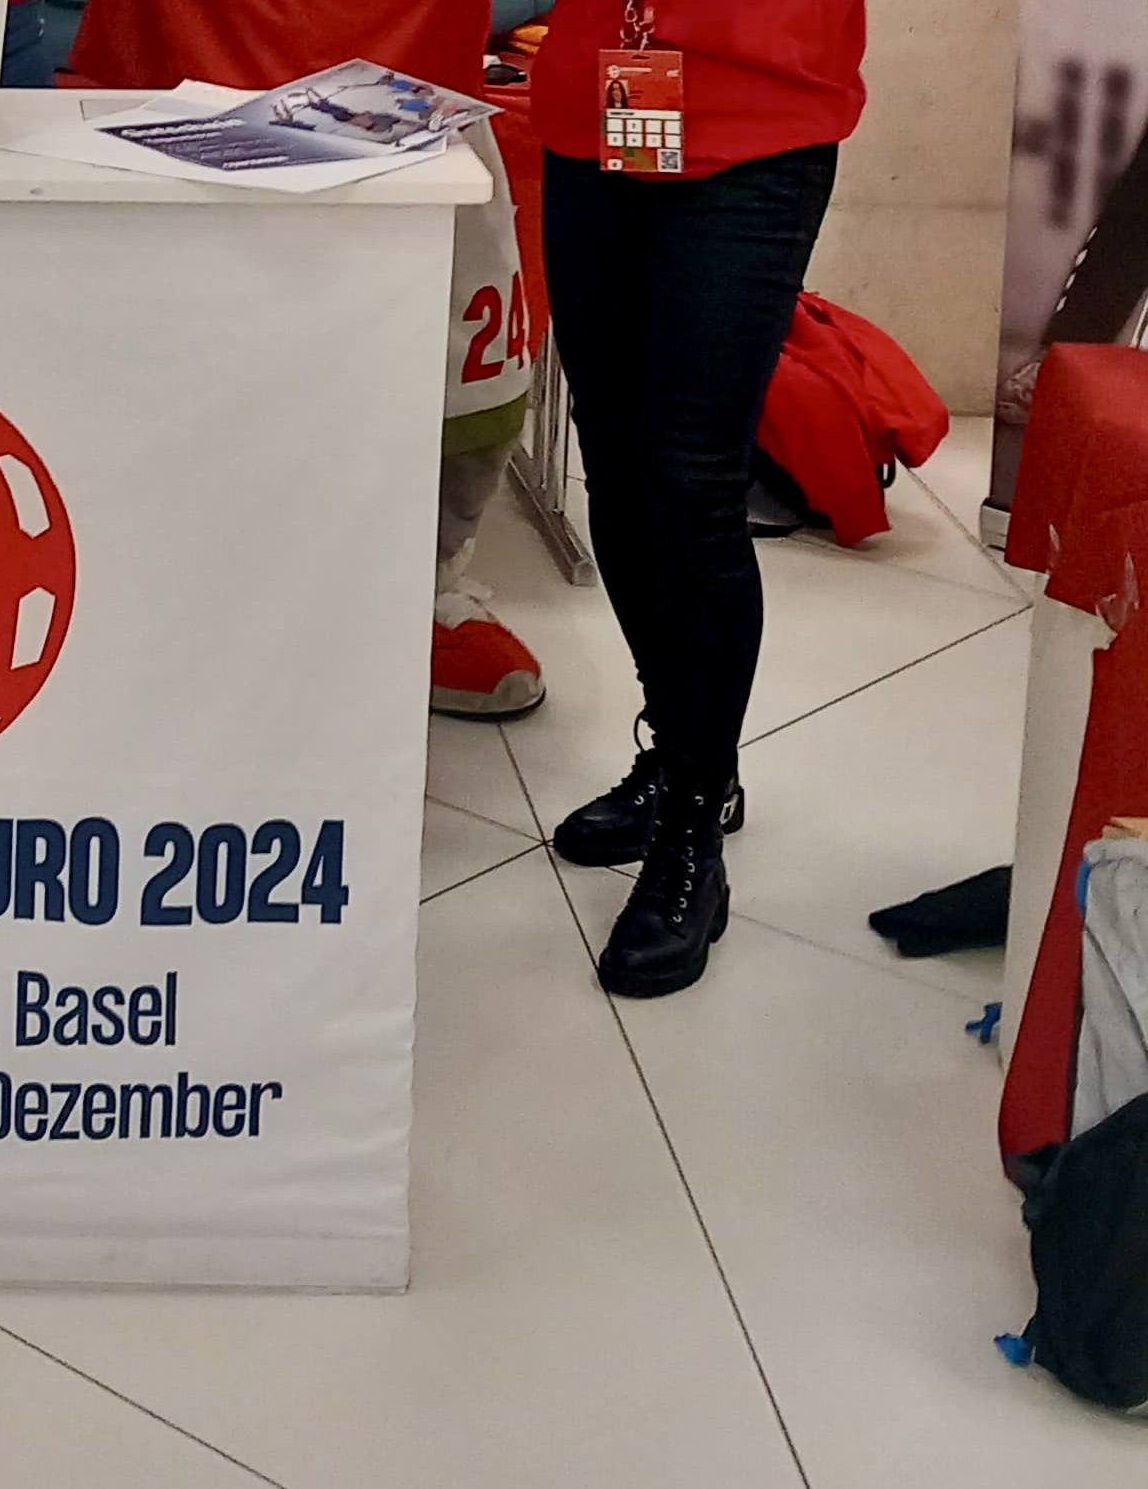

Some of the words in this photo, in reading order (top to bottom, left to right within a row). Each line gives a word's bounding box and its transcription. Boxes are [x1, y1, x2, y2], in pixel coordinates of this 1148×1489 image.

[461, 270, 526, 384] 24
[139, 818, 350, 926] 2024
[15, 970, 179, 1048] Basel
